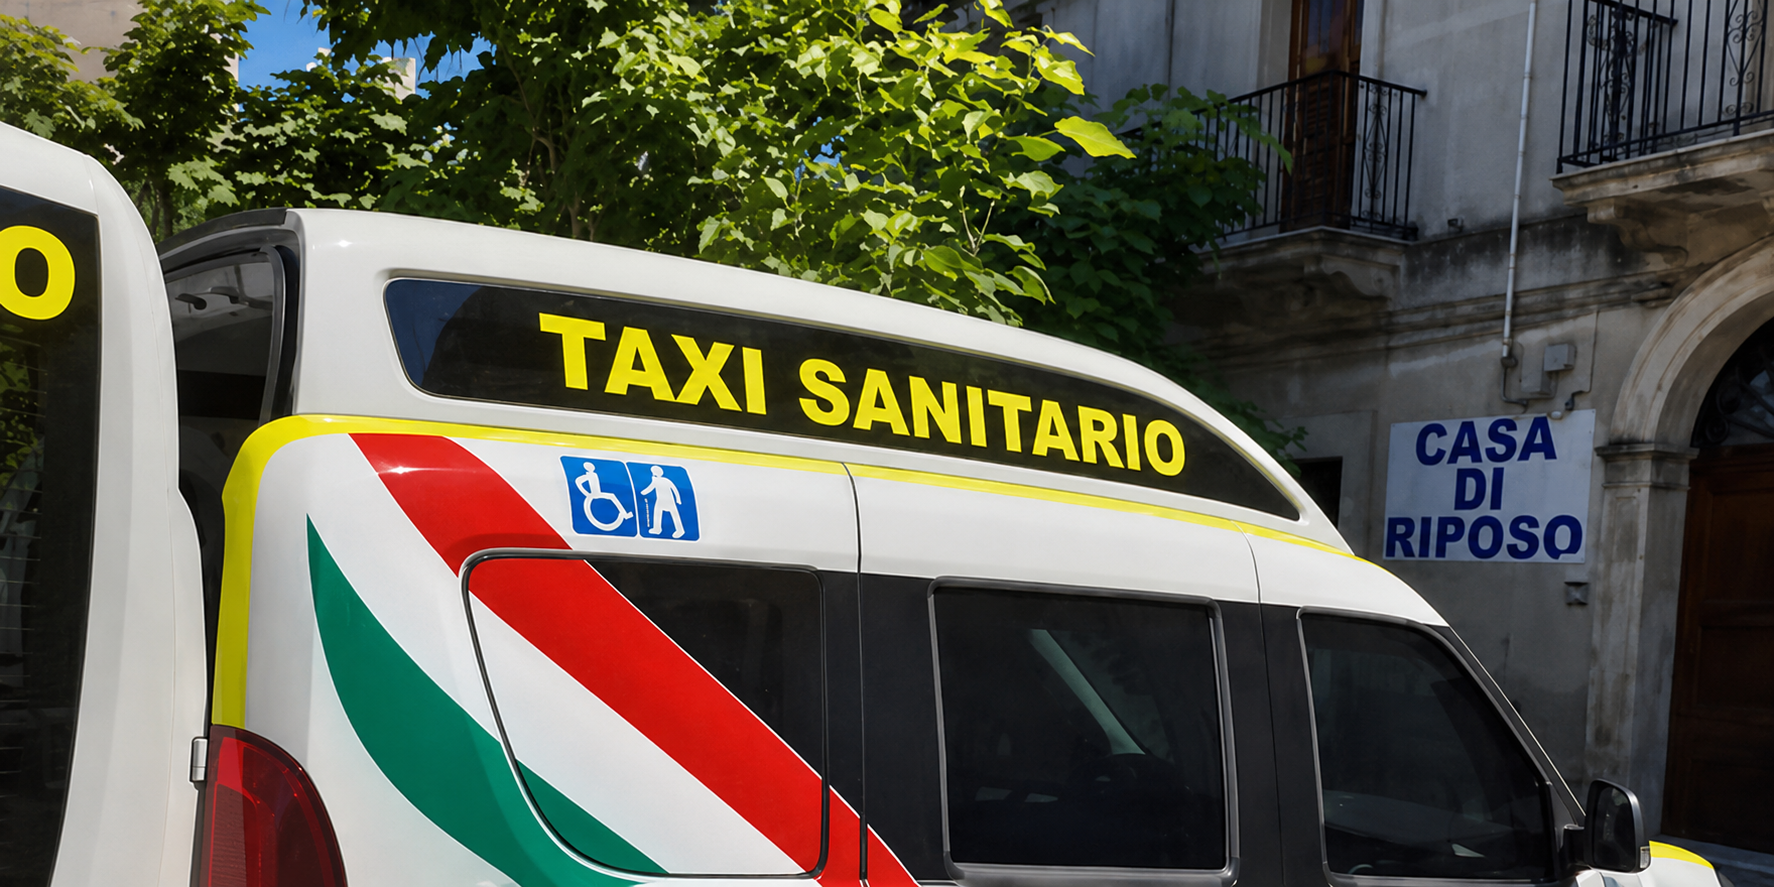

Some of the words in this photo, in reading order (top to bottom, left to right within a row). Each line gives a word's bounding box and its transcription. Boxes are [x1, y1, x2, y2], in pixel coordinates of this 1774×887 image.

[539, 313, 768, 415] TAXI
[798, 358, 1186, 478] SANITARIO
[1415, 416, 1558, 466] CASA
[1454, 467, 1505, 511] DI
[1385, 514, 1584, 560] RIPOSO
